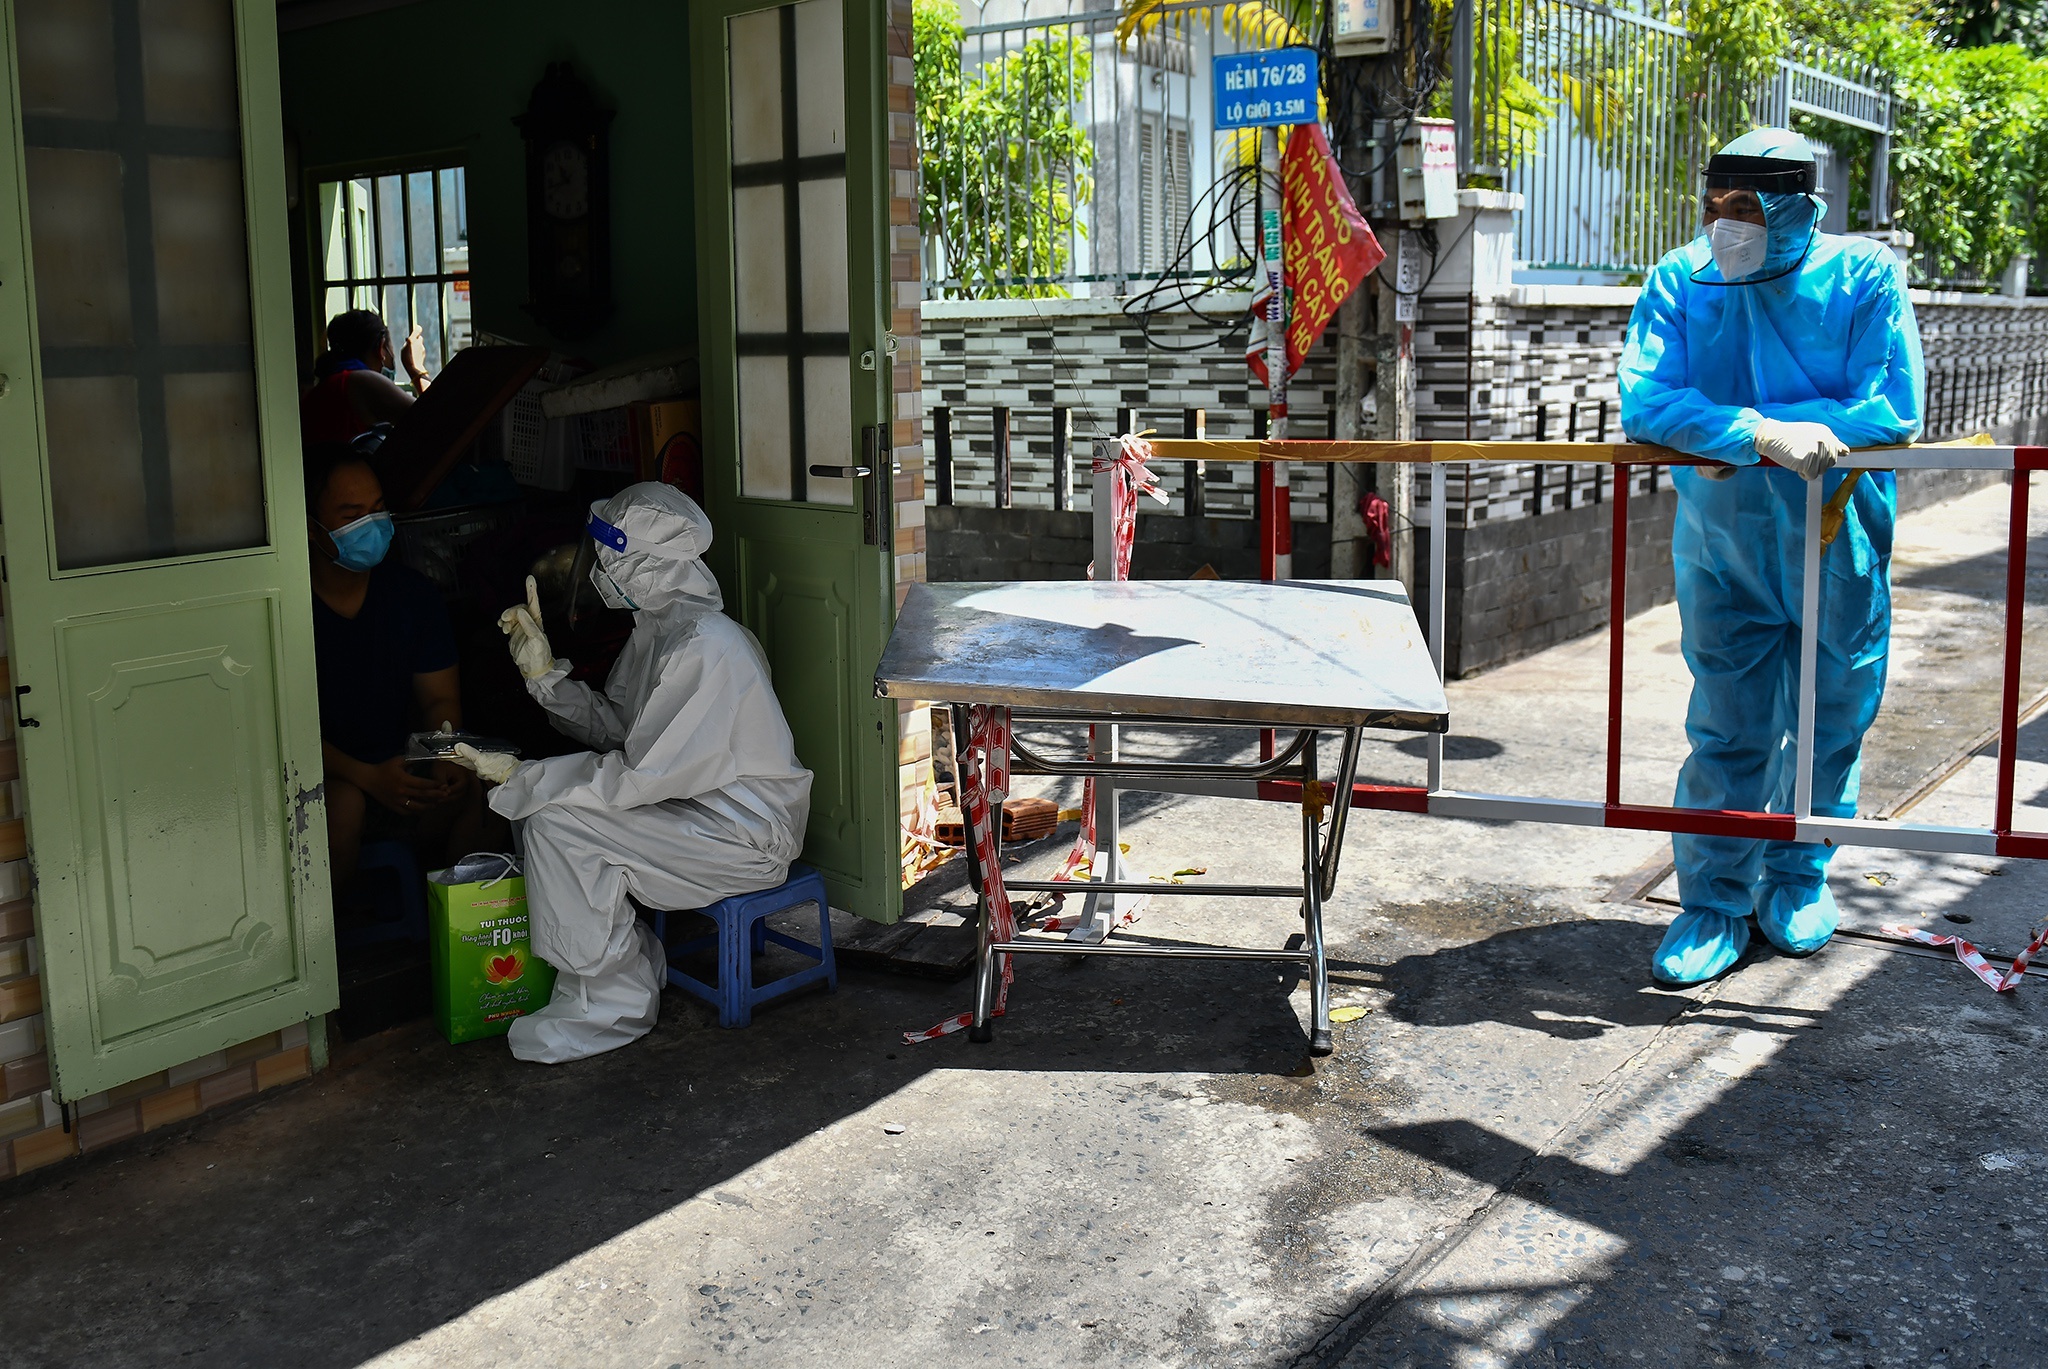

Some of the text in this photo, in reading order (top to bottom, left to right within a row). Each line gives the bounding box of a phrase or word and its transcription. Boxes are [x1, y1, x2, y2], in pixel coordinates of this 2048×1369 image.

[1225, 62, 1306, 91] HẺM 76/28
[1226, 101, 1243, 123] LỘ
[1273, 98, 1305, 117] 3.5M
[1303, 278, 1331, 328] CÂY
